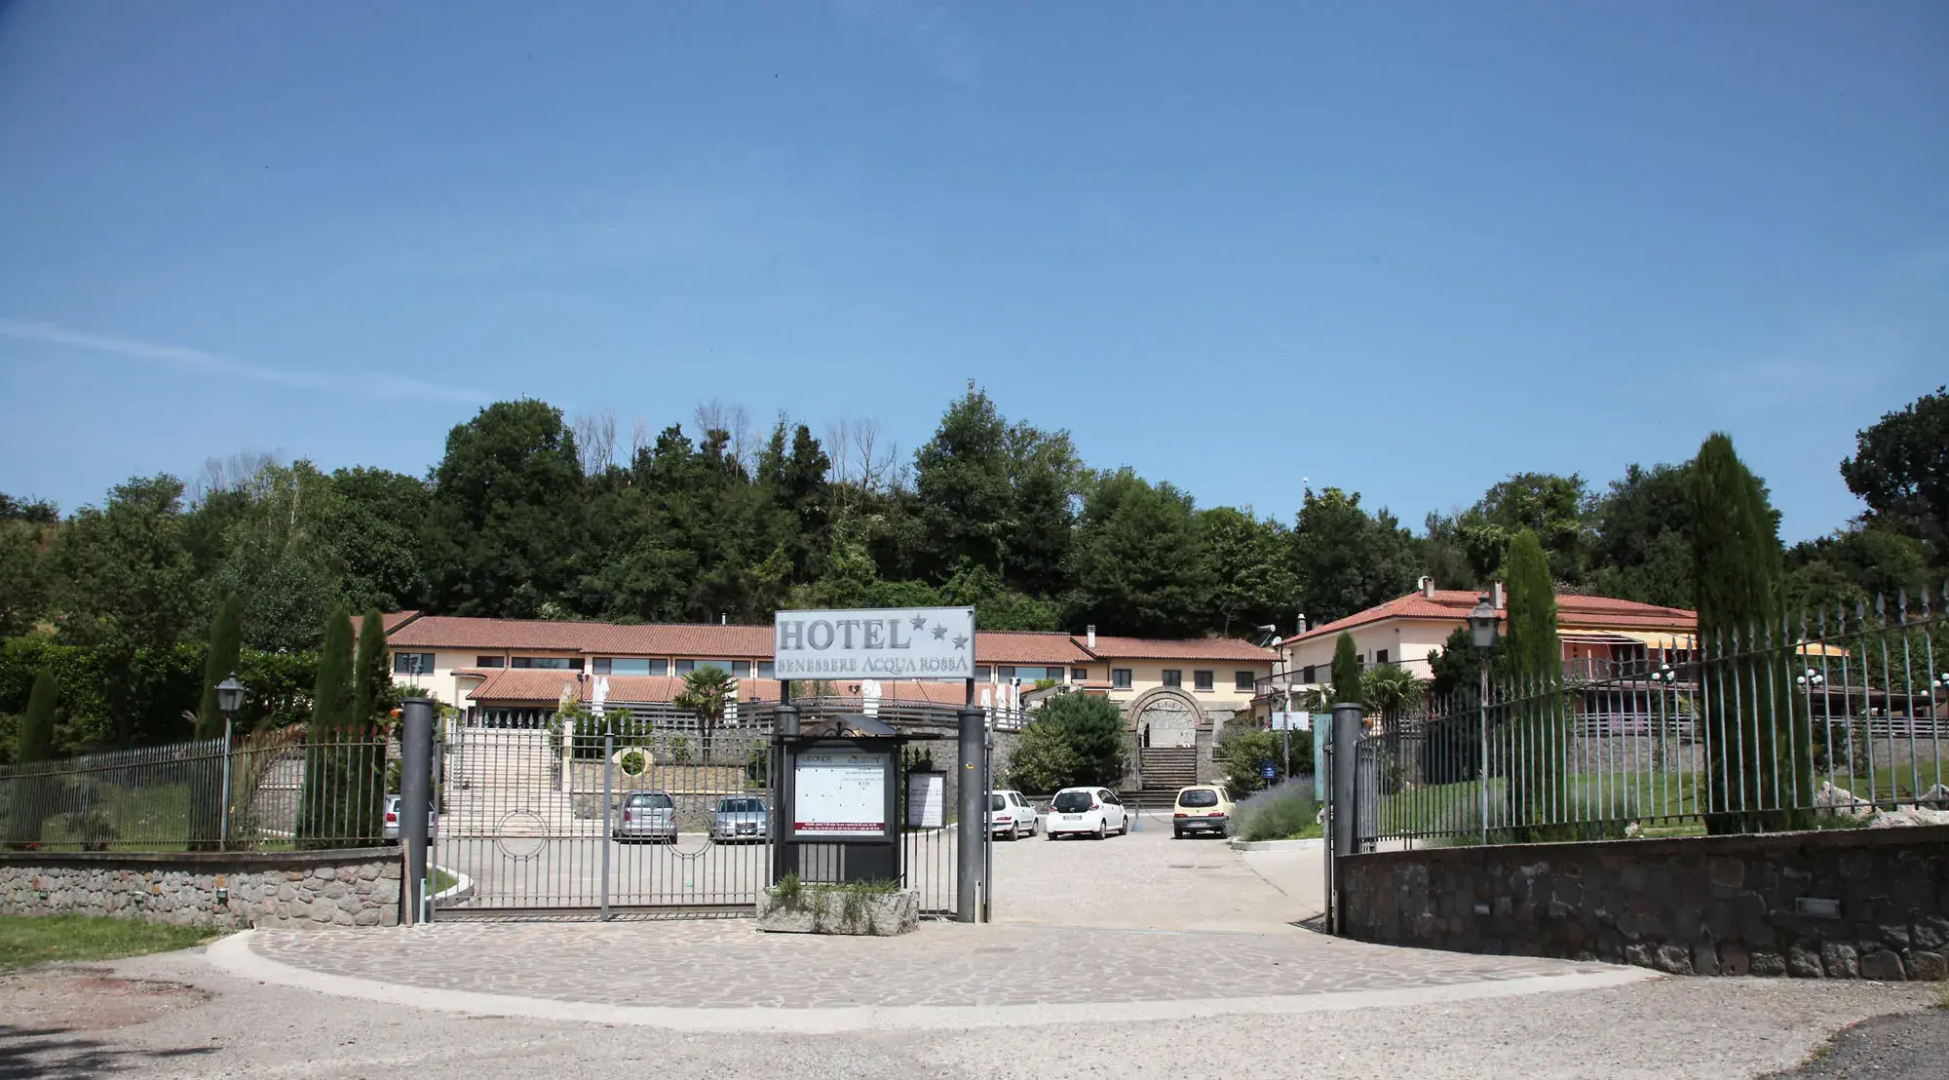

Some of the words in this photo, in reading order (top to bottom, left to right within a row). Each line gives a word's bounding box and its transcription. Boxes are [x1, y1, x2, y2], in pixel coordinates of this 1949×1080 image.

[779, 619, 911, 650] HOTEL
[778, 658, 858, 673] BENESSERE
[862, 656, 916, 675] ACQUA
[920, 655, 968, 672] ROSSA
